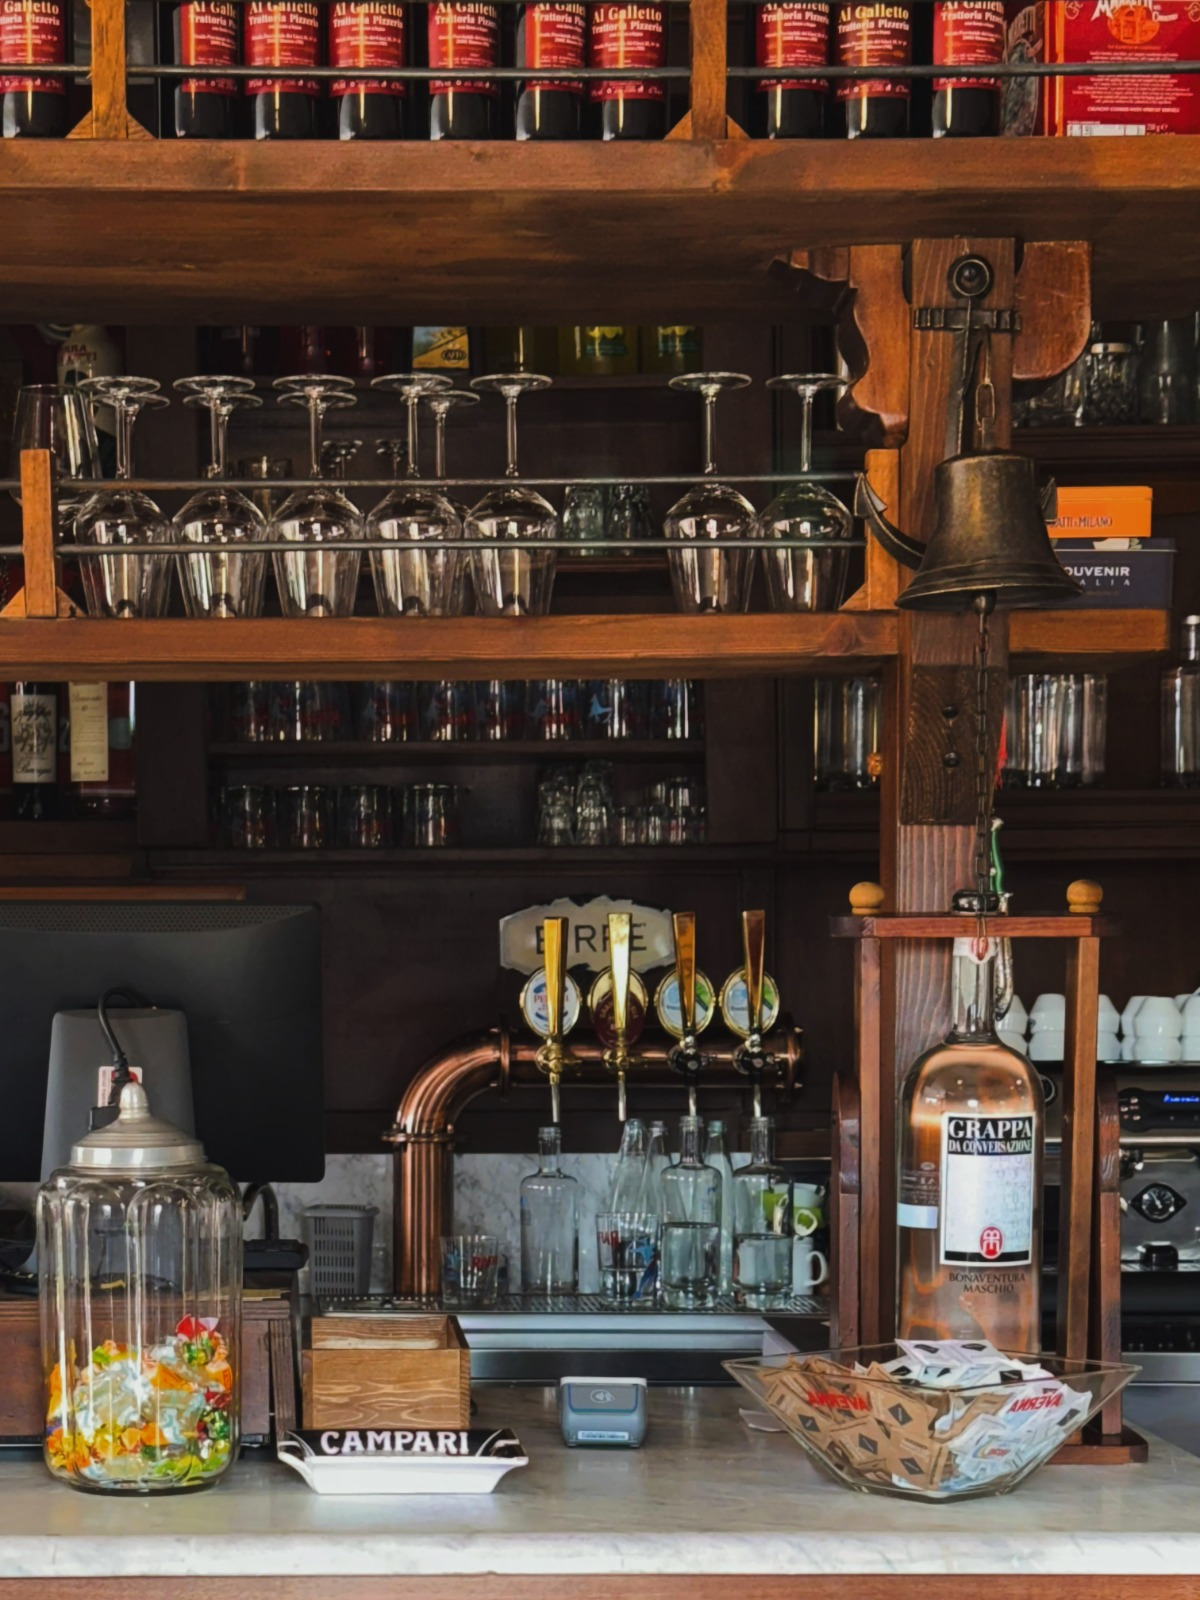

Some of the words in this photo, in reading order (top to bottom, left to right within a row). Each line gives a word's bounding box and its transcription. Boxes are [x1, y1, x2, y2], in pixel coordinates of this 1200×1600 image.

[592, 8, 605, 24] Al
[607, 4, 662, 21] Galletto
[761, 10, 803, 23] Trattoria
[839, 7, 851, 23] Al
[855, 4, 910, 20] Galletto
[591, 21, 628, 35] Trattoria
[630, 20, 663, 33] Pizzeria
[838, 19, 876, 34] Trattoria
[878, 18, 910, 31] Pizzeria
[1078, 516, 1113, 528] MILANO
[1062, 566, 1131, 577] OUVENIR
[1079, 578, 1131, 586] ALIA
[948, 1119, 1032, 1139] GRAPPA
[948, 1139, 962, 1153] DA
[962, 1139, 1032, 1154] CONVERSAZIONE
[949, 1271, 1026, 1283] BONAVENTURA
[963, 1284, 1014, 1294] MASCHIO
[320, 1430, 469, 1455] CAMPARI
